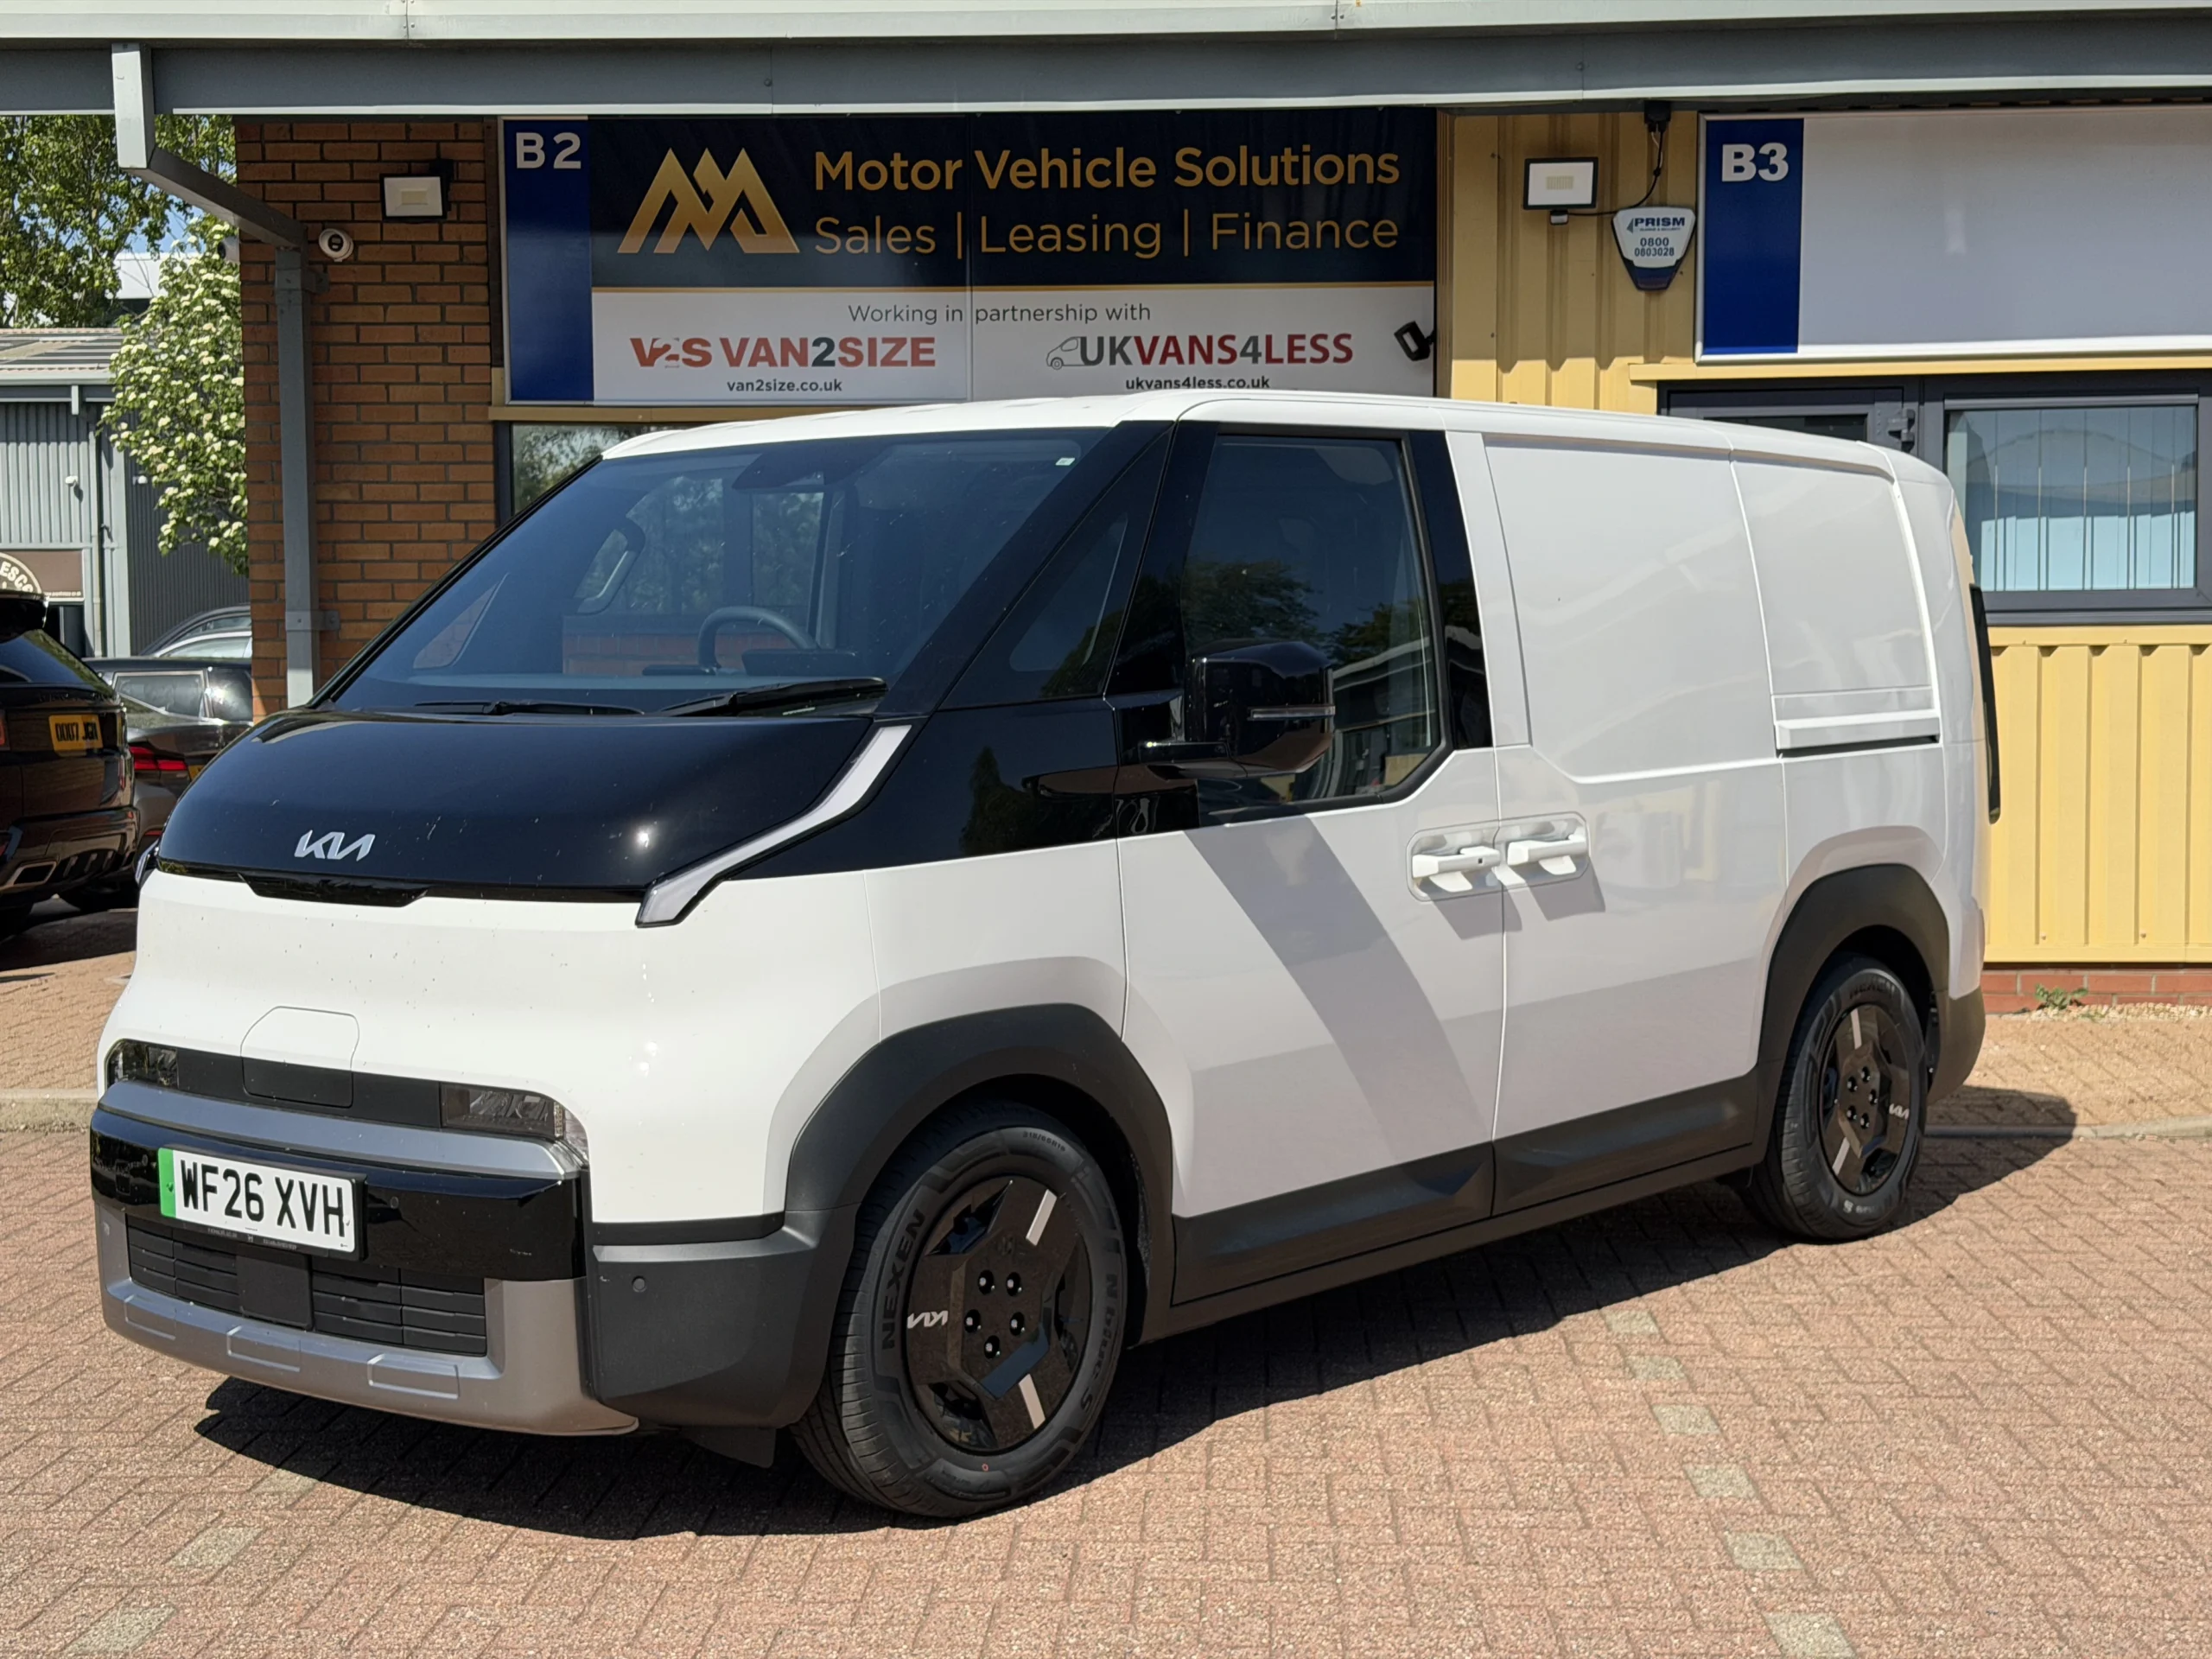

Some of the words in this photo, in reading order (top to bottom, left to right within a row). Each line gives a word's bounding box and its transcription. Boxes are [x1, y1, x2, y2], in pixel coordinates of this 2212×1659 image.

[516, 131, 582, 169] B2
[1721, 142, 1789, 182] B3
[815, 151, 963, 191] Motor
[975, 146, 1157, 189] Vehicle
[1173, 144, 1400, 187] Solutions
[815, 215, 937, 255] Sales
[981, 214, 1162, 259] Leasing
[1211, 212, 1399, 251] Finance
[1635, 217, 1685, 227] PRISM
[1640, 238, 1669, 247] 0800
[849, 305, 938, 326] Working
[945, 306, 964, 323] in
[976, 302, 1098, 326] partnership
[1106, 302, 1151, 321] with
[719, 336, 936, 368] VAN2SIZE
[1079, 334, 1354, 366] UKVANS4LESS
[727, 378, 842, 393] van2size.co.uk
[1126, 376, 1270, 390] ukvans4less.co.uk
[295, 830, 375, 861] KIA
[181, 1160, 264, 1223] WF26
[275, 1176, 345, 1237] XVH
[882, 1209, 925, 1350] NEXEN
